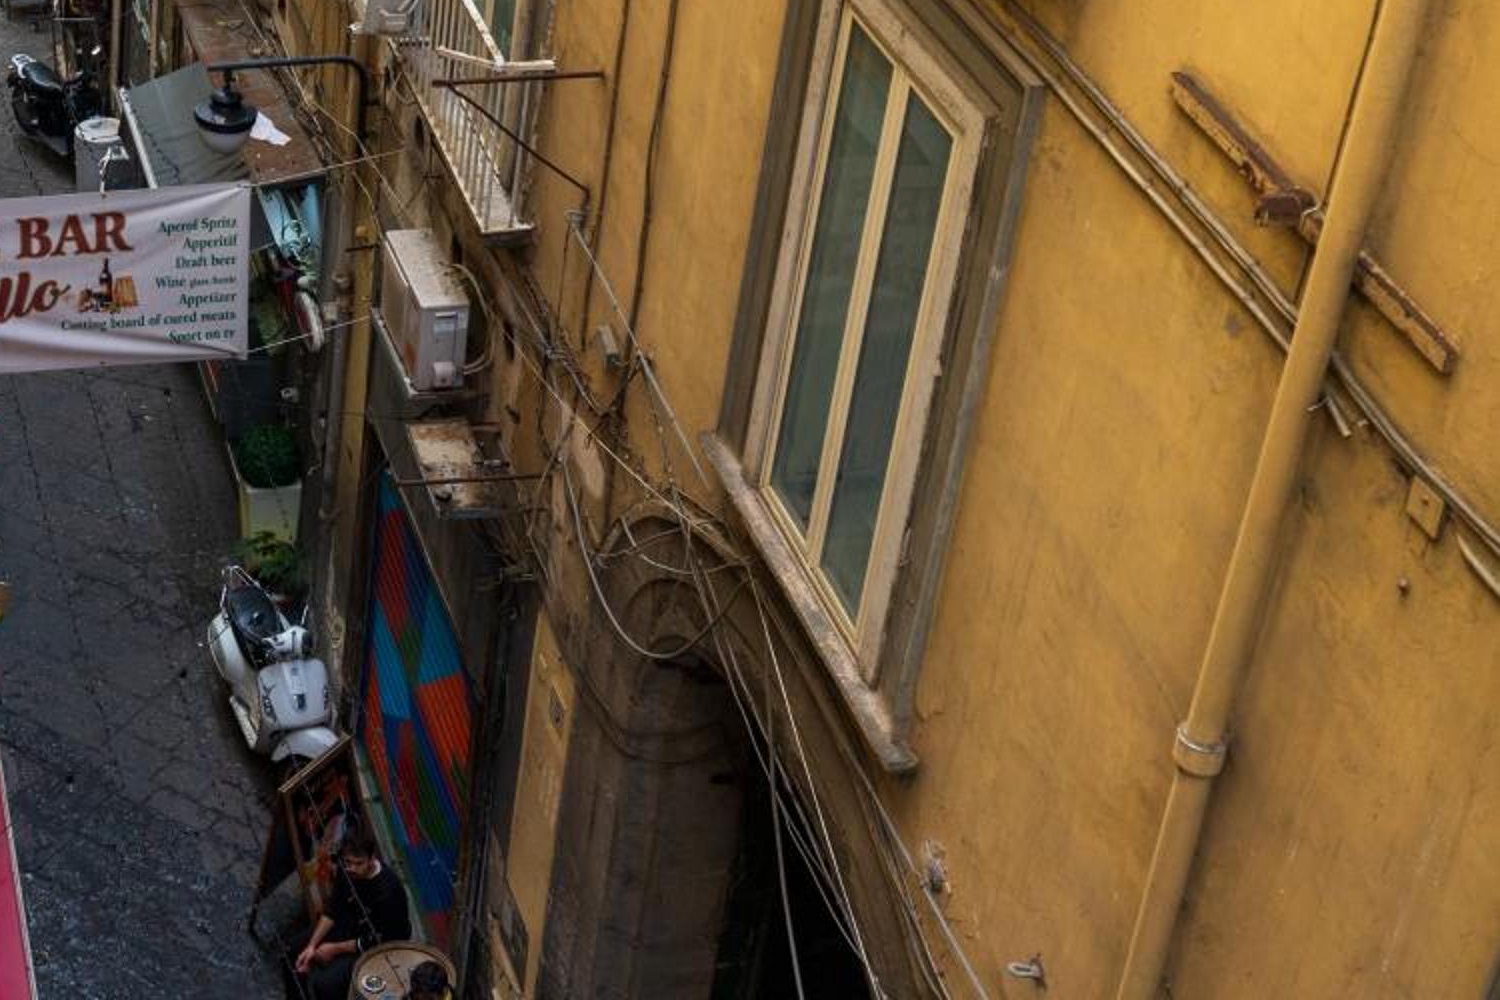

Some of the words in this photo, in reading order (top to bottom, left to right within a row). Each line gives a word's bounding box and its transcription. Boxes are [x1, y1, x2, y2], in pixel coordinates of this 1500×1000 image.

[158, 217, 199, 236] Aperol
[201, 216, 238, 233] Spritz
[16, 211, 134, 260] BAR
[175, 255, 208, 269] Draft
[211, 253, 237, 267] beer
[155, 277, 187, 289] Wine
[179, 292, 238, 309] Appetizer
[110, 315, 145, 329] board
[148, 313, 162, 327] of
[163, 311, 198, 324] cured
[201, 309, 237, 322] meats
